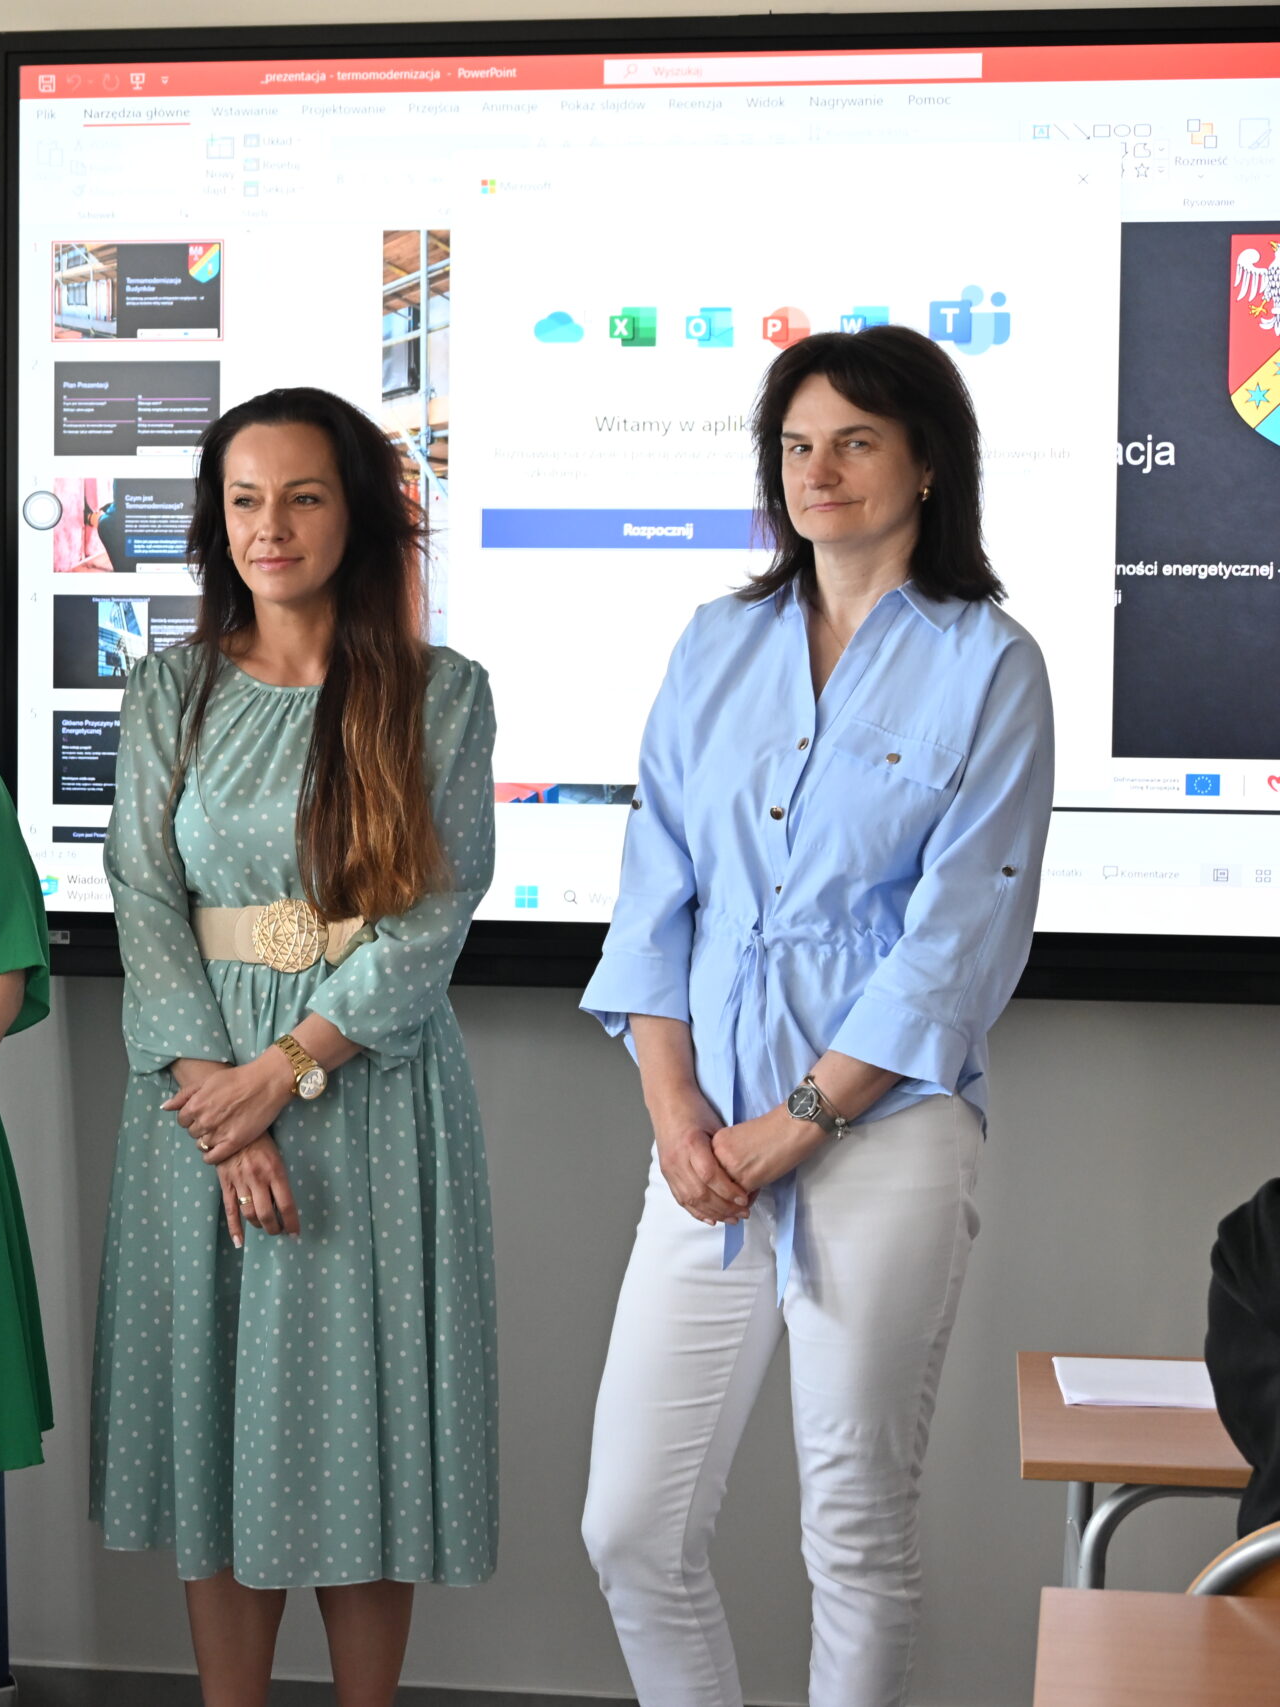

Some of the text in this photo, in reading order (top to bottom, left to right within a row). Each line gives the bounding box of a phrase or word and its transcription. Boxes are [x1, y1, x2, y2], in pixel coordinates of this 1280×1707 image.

[337, 67, 440, 82] termomodernizacja
[457, 67, 517, 79] PowerPoint
[36, 94, 952, 122] Plik Narzędzia główne Wstawianie Projektowanie Przejścia Animacje Pokaz slajdów Recenzja Widok Nagrywanie Pomoc
[1174, 154, 1228, 167] Rozmieść
[1182, 197, 1236, 209] Rysowanie
[594, 414, 672, 437] Witamy
[679, 418, 695, 432] w
[624, 523, 693, 538] Rozpocznij
[1115, 560, 1274, 580] ności energetycznej
[1120, 869, 1181, 880] Komentarze
